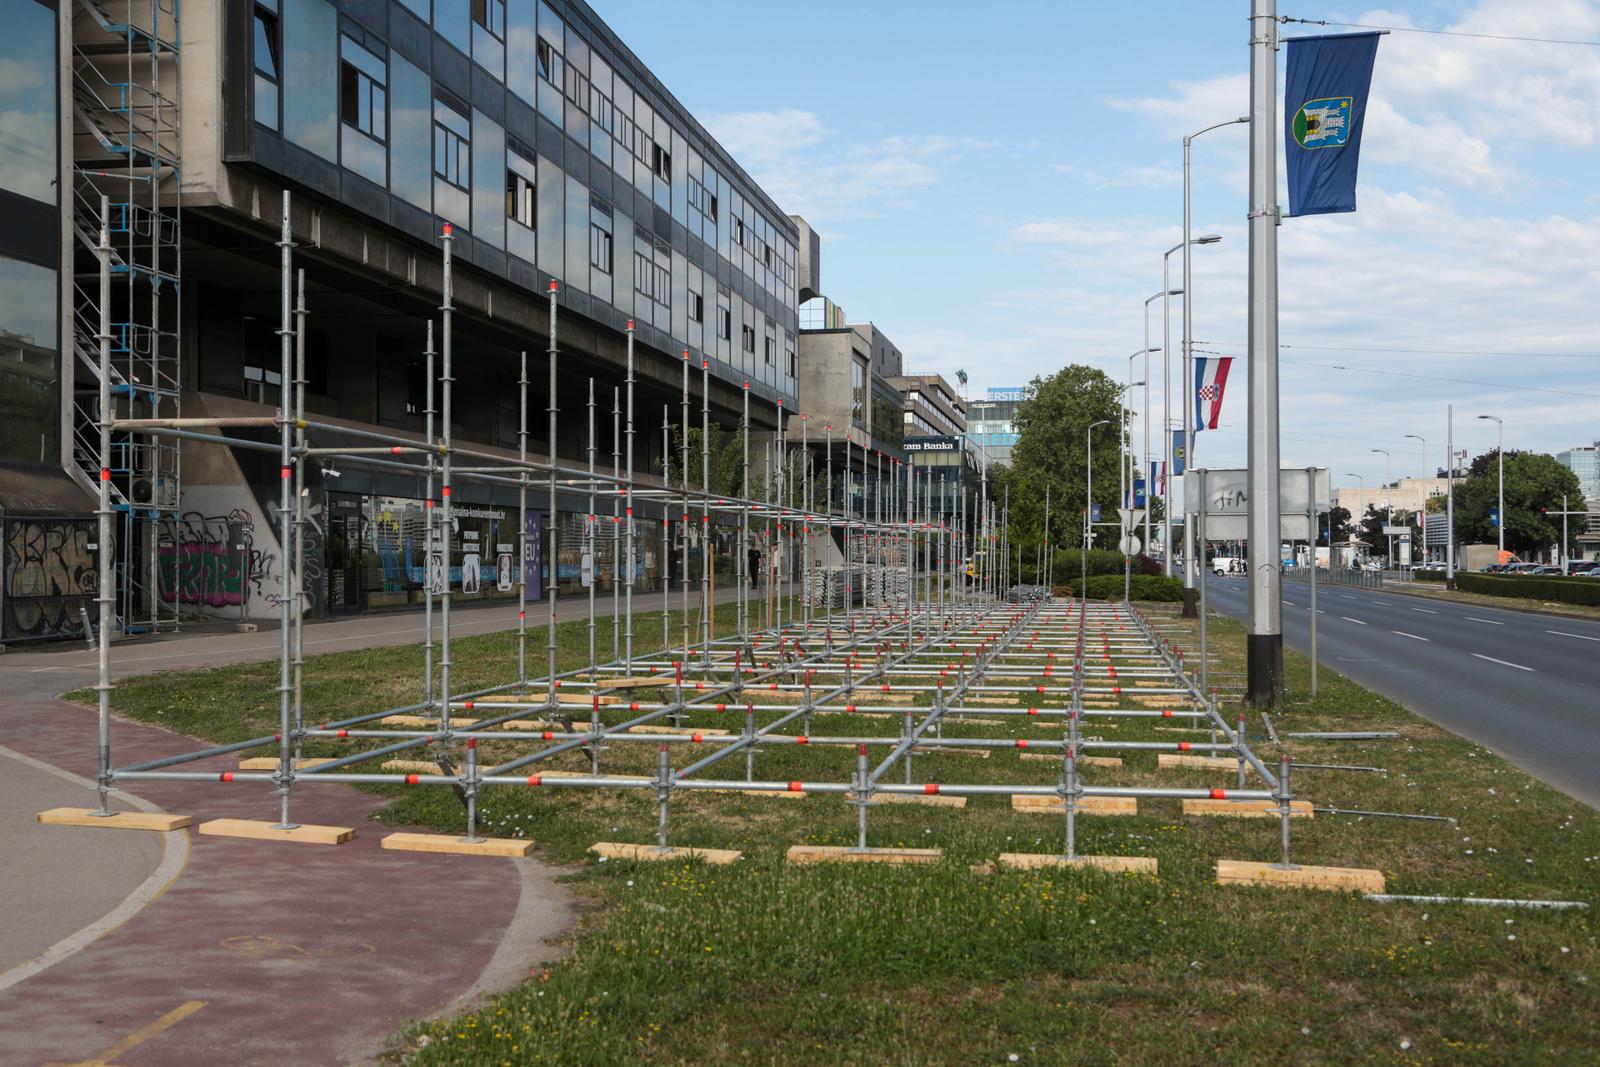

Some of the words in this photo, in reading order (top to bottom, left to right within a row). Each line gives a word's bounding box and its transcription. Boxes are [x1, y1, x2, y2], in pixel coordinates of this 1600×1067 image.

[988, 392, 1020, 401] ERSTE
[924, 442, 953, 450] Banka
[525, 543, 536, 561] EU
